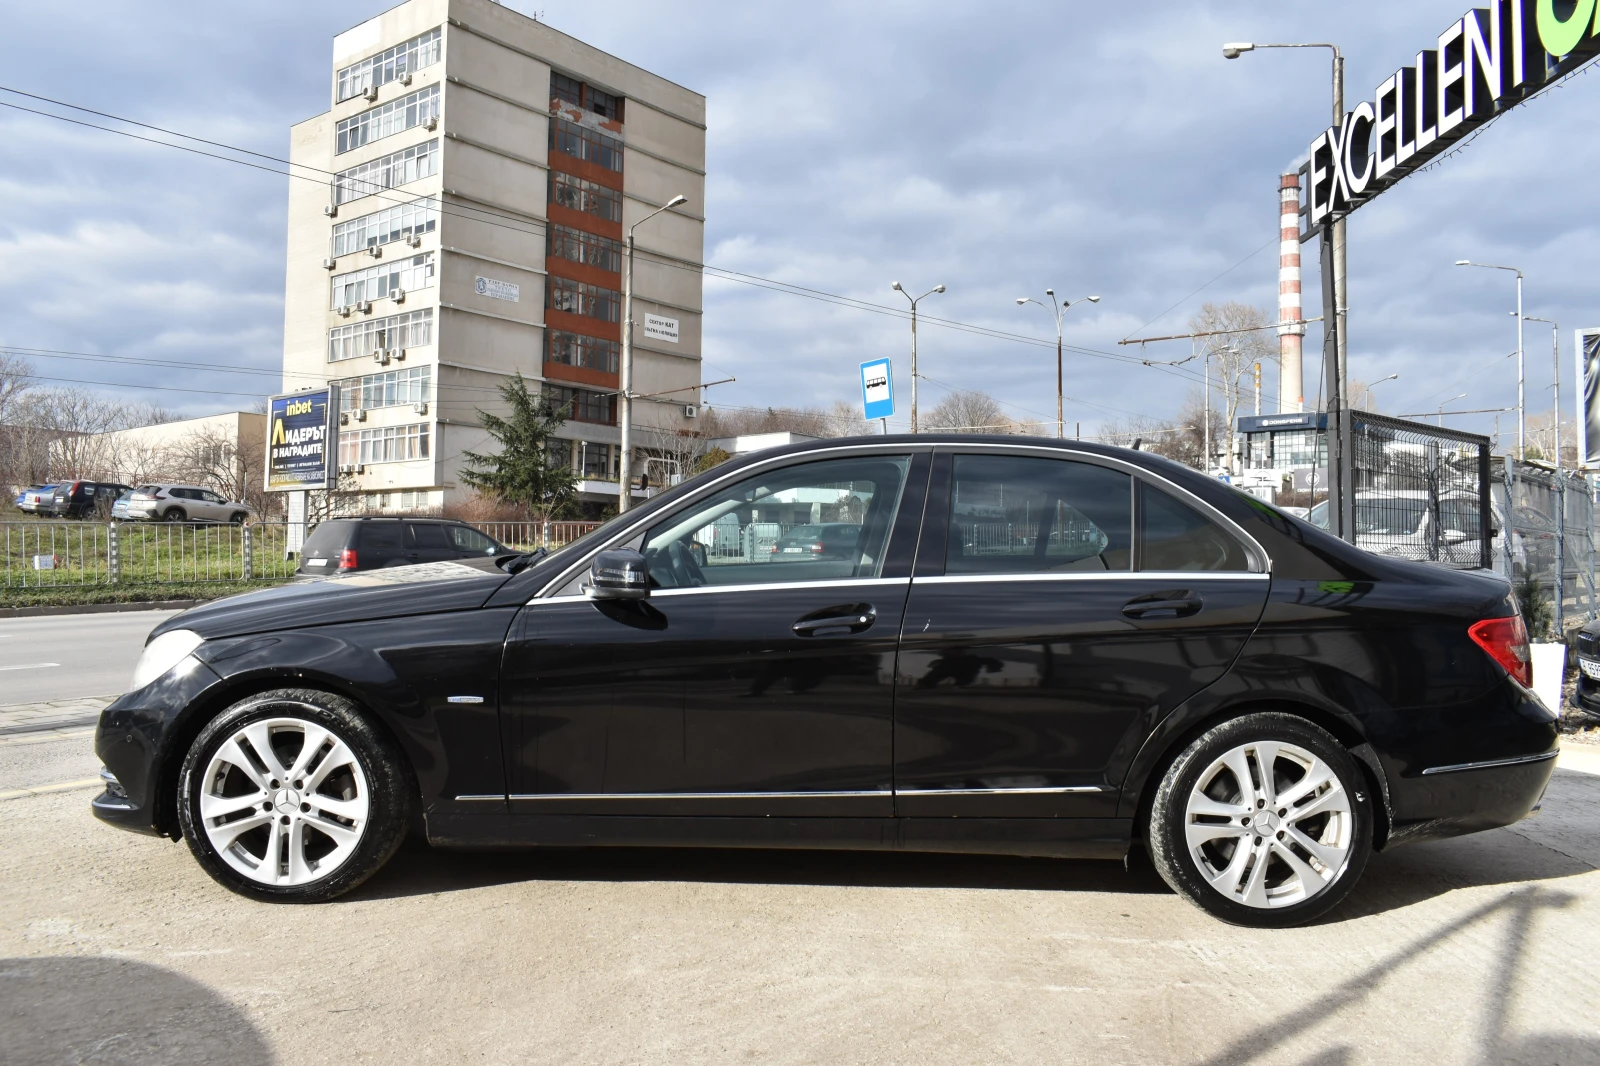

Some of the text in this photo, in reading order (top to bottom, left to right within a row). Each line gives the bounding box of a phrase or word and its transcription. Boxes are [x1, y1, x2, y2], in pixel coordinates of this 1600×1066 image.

[1310, 0, 1524, 224] EXCELLENT
[665, 321, 674, 329] КАТ
[286, 399, 312, 416] inbet
[271, 418, 326, 446] ЛИДЕРЪТ
[273, 442, 323, 459] В НАГРАДИТЕ
